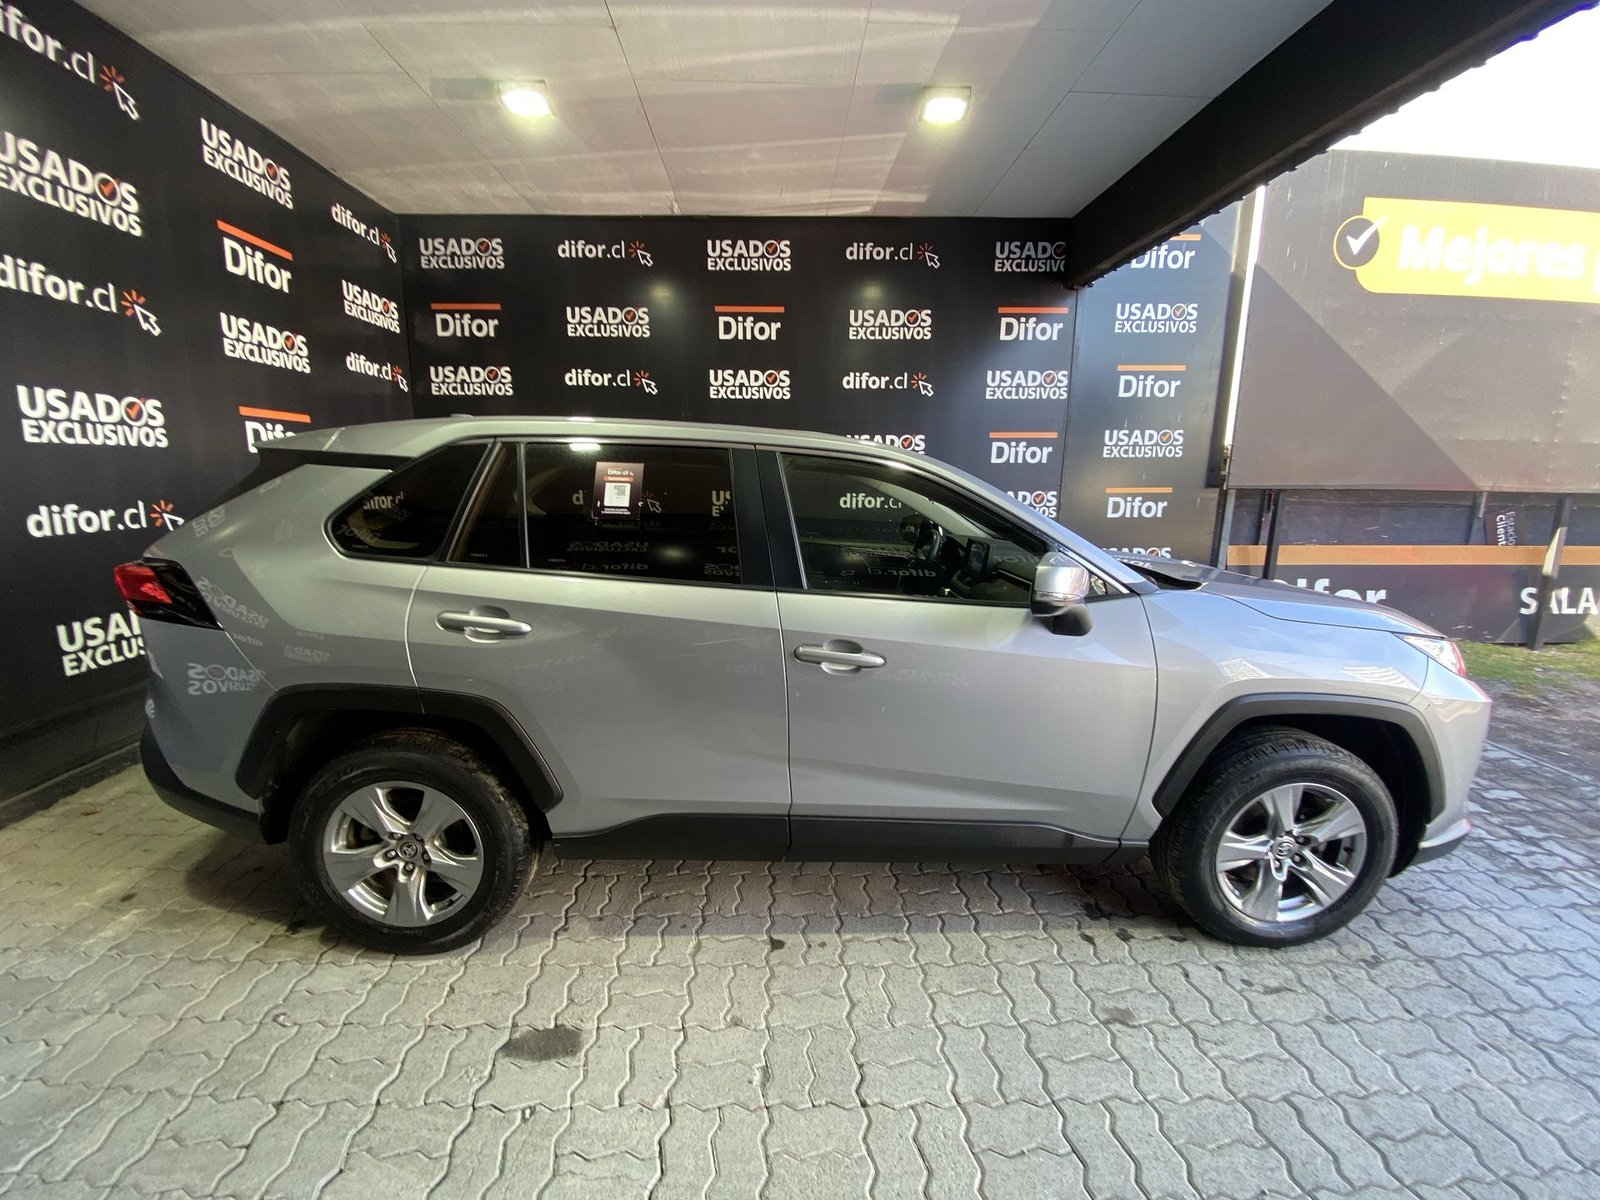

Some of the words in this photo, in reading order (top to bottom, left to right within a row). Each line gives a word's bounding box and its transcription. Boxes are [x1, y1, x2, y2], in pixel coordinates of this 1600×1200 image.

[0, 0, 96, 84] ifor.cl
[201, 118, 290, 191] USADOS
[203, 145, 293, 209] EXCLUSIVOS
[331, 203, 380, 246] difor.cl
[419, 238, 504, 256] USADOS
[558, 240, 625, 258] difor.cl
[707, 239, 791, 258] USADOS
[845, 242, 913, 260] difor.cl
[995, 241, 1067, 259] USADO
[1131, 244, 1195, 269] Difor
[1398, 225, 1585, 286] Mejores
[223, 237, 291, 293] Difor
[421, 256, 505, 269] EXCLUSIVOS
[707, 258, 791, 272] EXCLUSIVOS
[994, 259, 1065, 272] EXCLUSIV
[0, 254, 117, 313] difor.cl
[342, 280, 398, 318] USADOS
[344, 302, 400, 333] EXCLUSIVOS
[566, 306, 649, 325] USADOS
[849, 309, 932, 327] USADOS
[1116, 303, 1198, 320] USADOS
[435, 313, 499, 337] Difor
[567, 324, 650, 338] EXCLUSIVOS
[718, 316, 781, 340] Difor
[849, 326, 932, 340] EXCLUSIVOS
[1000, 317, 1063, 341] Difor
[1114, 321, 1197, 333] EXCLUSIVOS
[220, 312, 307, 359] USADOS
[223, 341, 310, 374] EXCLUSIVOS
[346, 352, 392, 381] difor.cl
[430, 366, 512, 384] USADOS
[565, 369, 631, 387] difor.cl
[709, 369, 790, 387] USADOS
[842, 372, 908, 389] difor.cl
[986, 370, 1068, 387] USADOS
[431, 382, 513, 396] EXCLUSIVOS
[709, 387, 790, 399] EXCLUSIVOS
[985, 386, 1068, 400] EXCLUSIVOS
[1118, 375, 1181, 397] Difor
[16, 385, 164, 427] USADOS
[21, 419, 168, 448] EXCLUSIVOS
[1104, 429, 1184, 446] USADOS
[990, 441, 1053, 464] Difor
[1103, 445, 1183, 458] EXCLUSIVOS
[1106, 496, 1168, 519] Difor
[27, 500, 147, 538] difor.cl
[56, 610, 141, 652] USA
[62, 636, 146, 676] EXCLU
